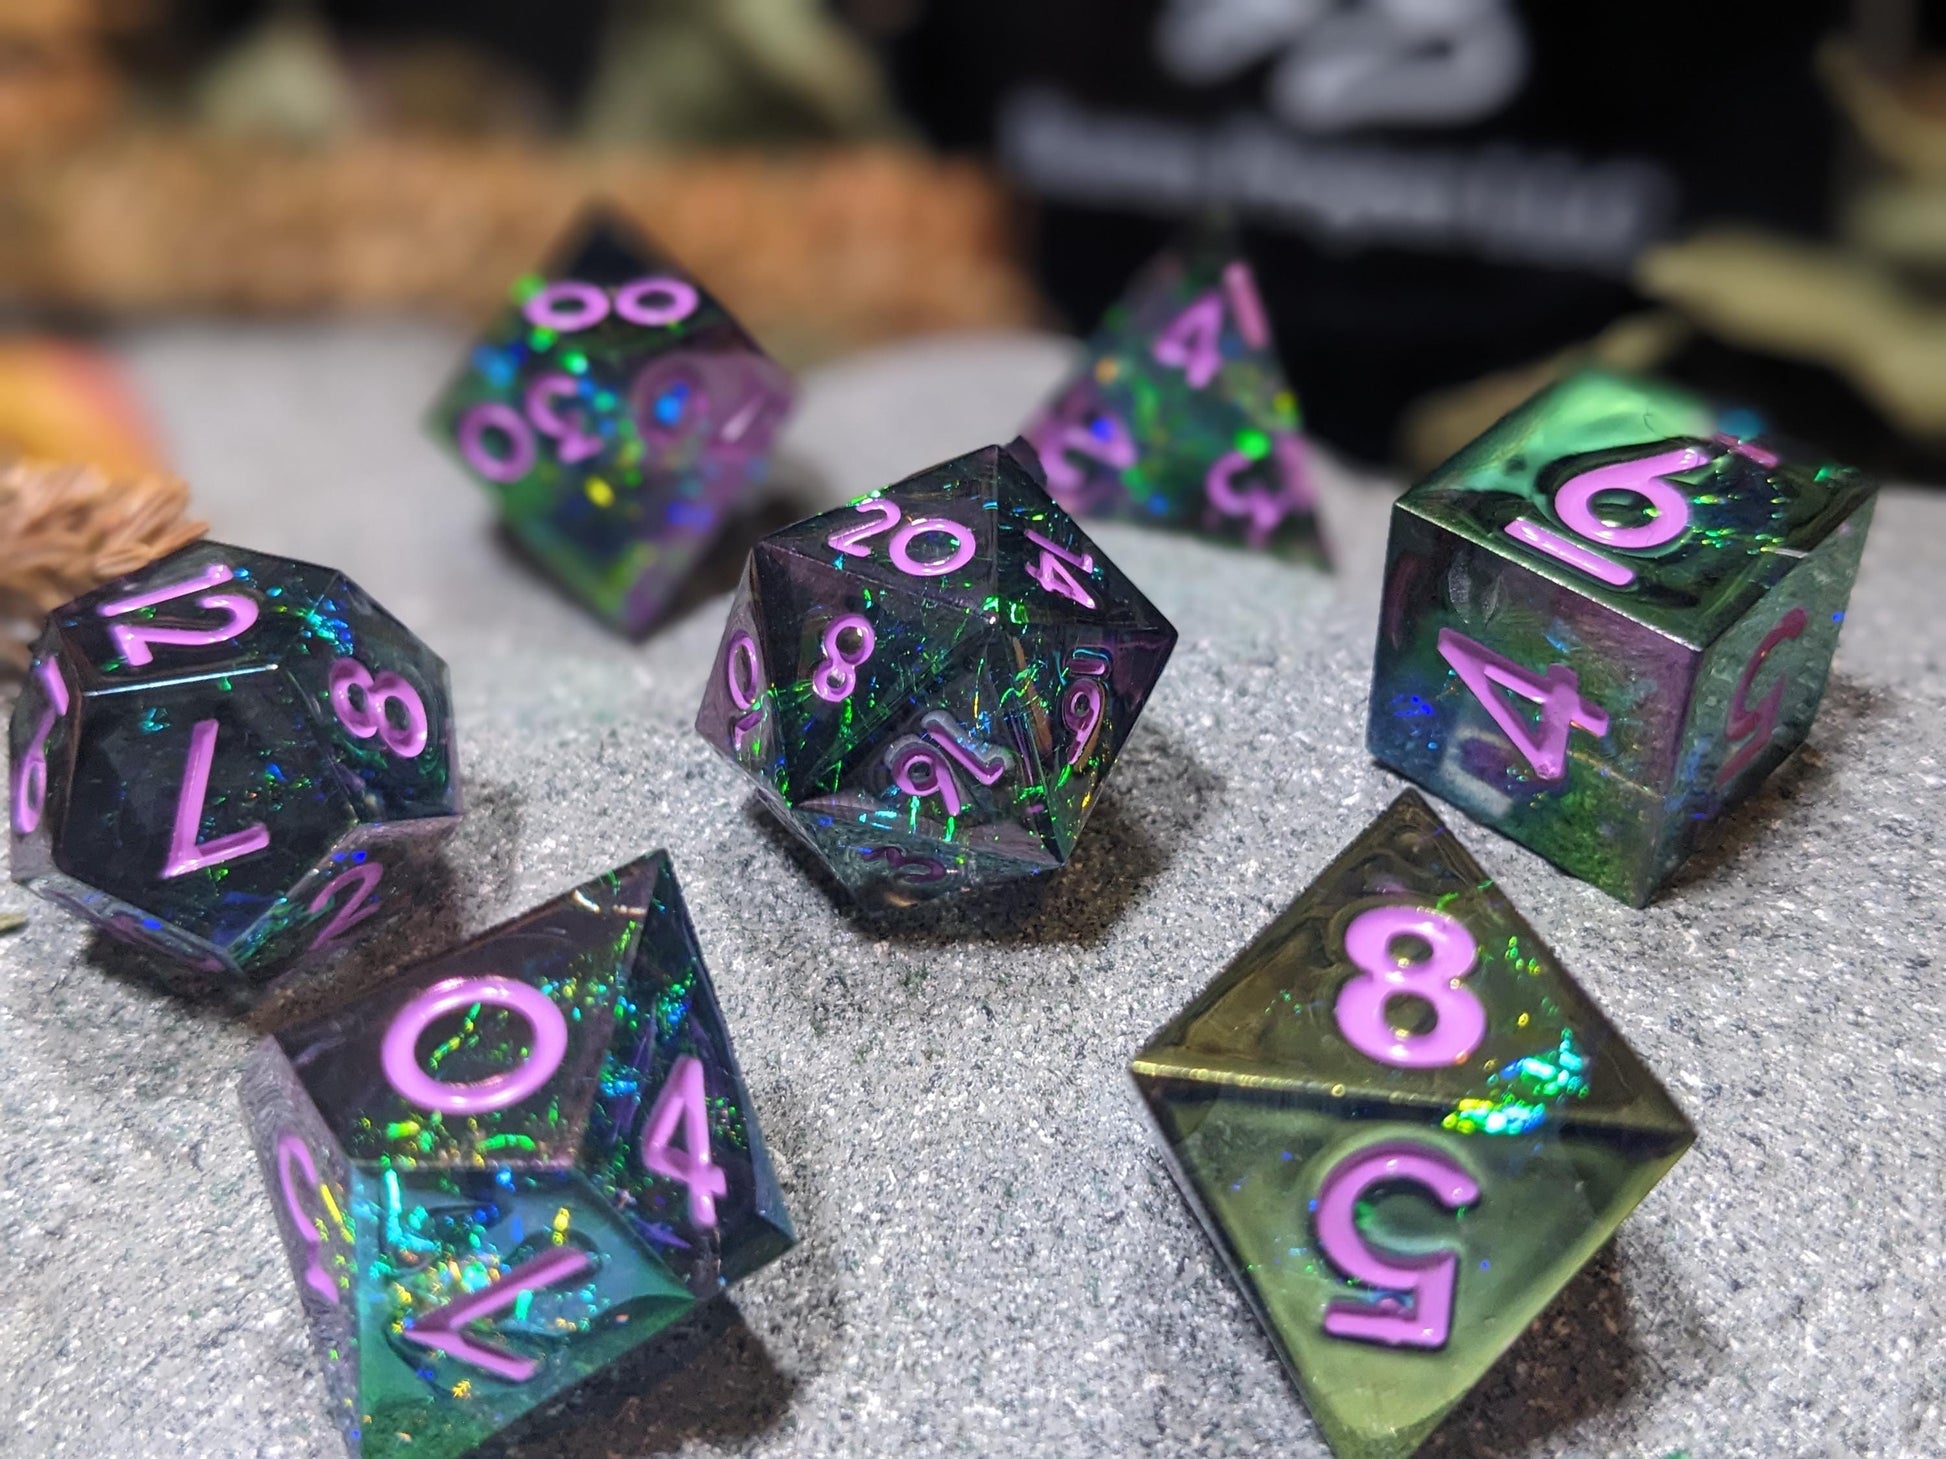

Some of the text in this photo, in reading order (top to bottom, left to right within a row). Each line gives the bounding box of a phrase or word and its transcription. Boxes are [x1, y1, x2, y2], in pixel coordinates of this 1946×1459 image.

[523, 275, 699, 333] 00
[1155, 290, 1223, 389] 4
[828, 498, 977, 578] 20
[1024, 527, 1098, 610] 14
[99, 562, 261, 668] 12
[813, 612, 877, 703] 8
[329, 656, 429, 759] 8
[726, 628, 765, 752] 10
[1437, 626, 1610, 782] 4
[1725, 606, 1809, 788] 5
[160, 717, 271, 881] 7
[890, 714, 1008, 818] 16
[308, 861, 384, 953] 2
[1334, 905, 1487, 1069] 8
[380, 974, 569, 1116] 0
[642, 1054, 748, 1228] 4
[1313, 1138, 1481, 1348] 5
[403, 1244, 592, 1384] 7
